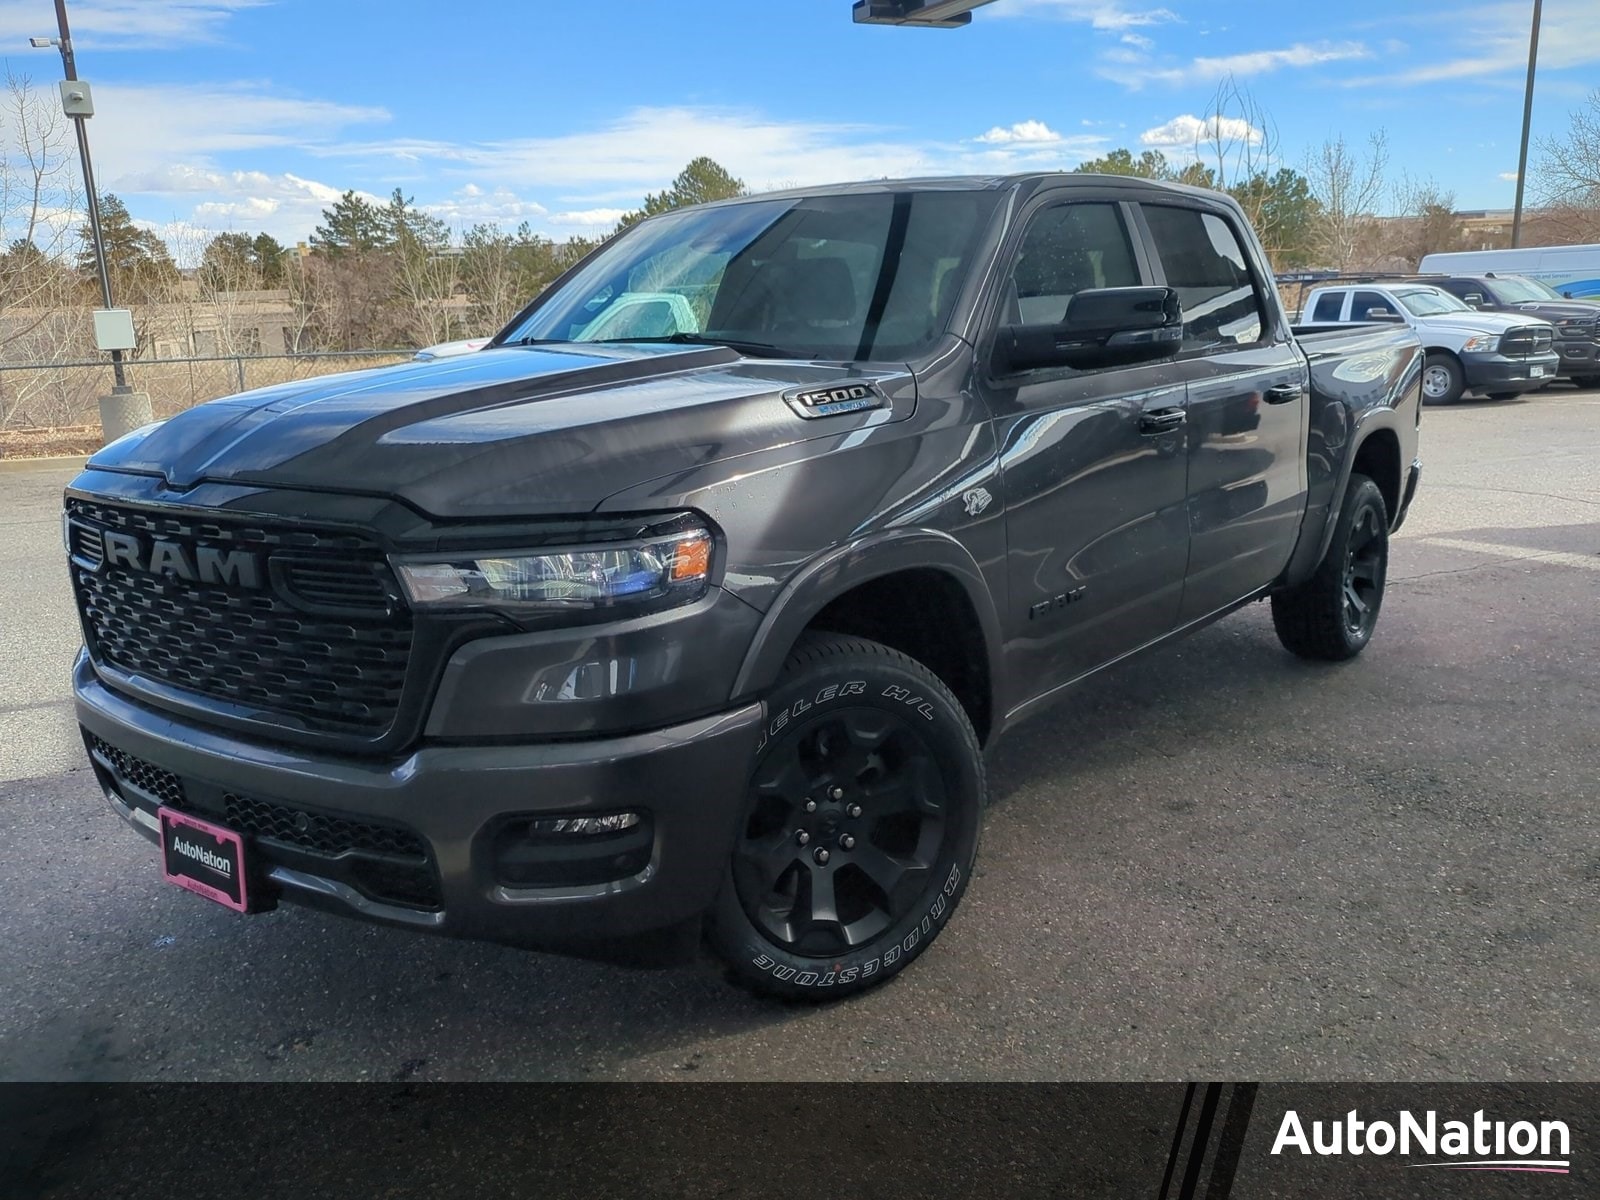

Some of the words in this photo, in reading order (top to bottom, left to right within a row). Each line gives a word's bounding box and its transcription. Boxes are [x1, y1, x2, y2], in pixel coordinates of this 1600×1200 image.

[801, 387, 866, 407] 1500
[104, 531, 264, 590] RAM
[881, 684, 936, 722] H/L
[173, 836, 232, 873] AutoNation
[752, 863, 962, 987] BRIDGESTONE
